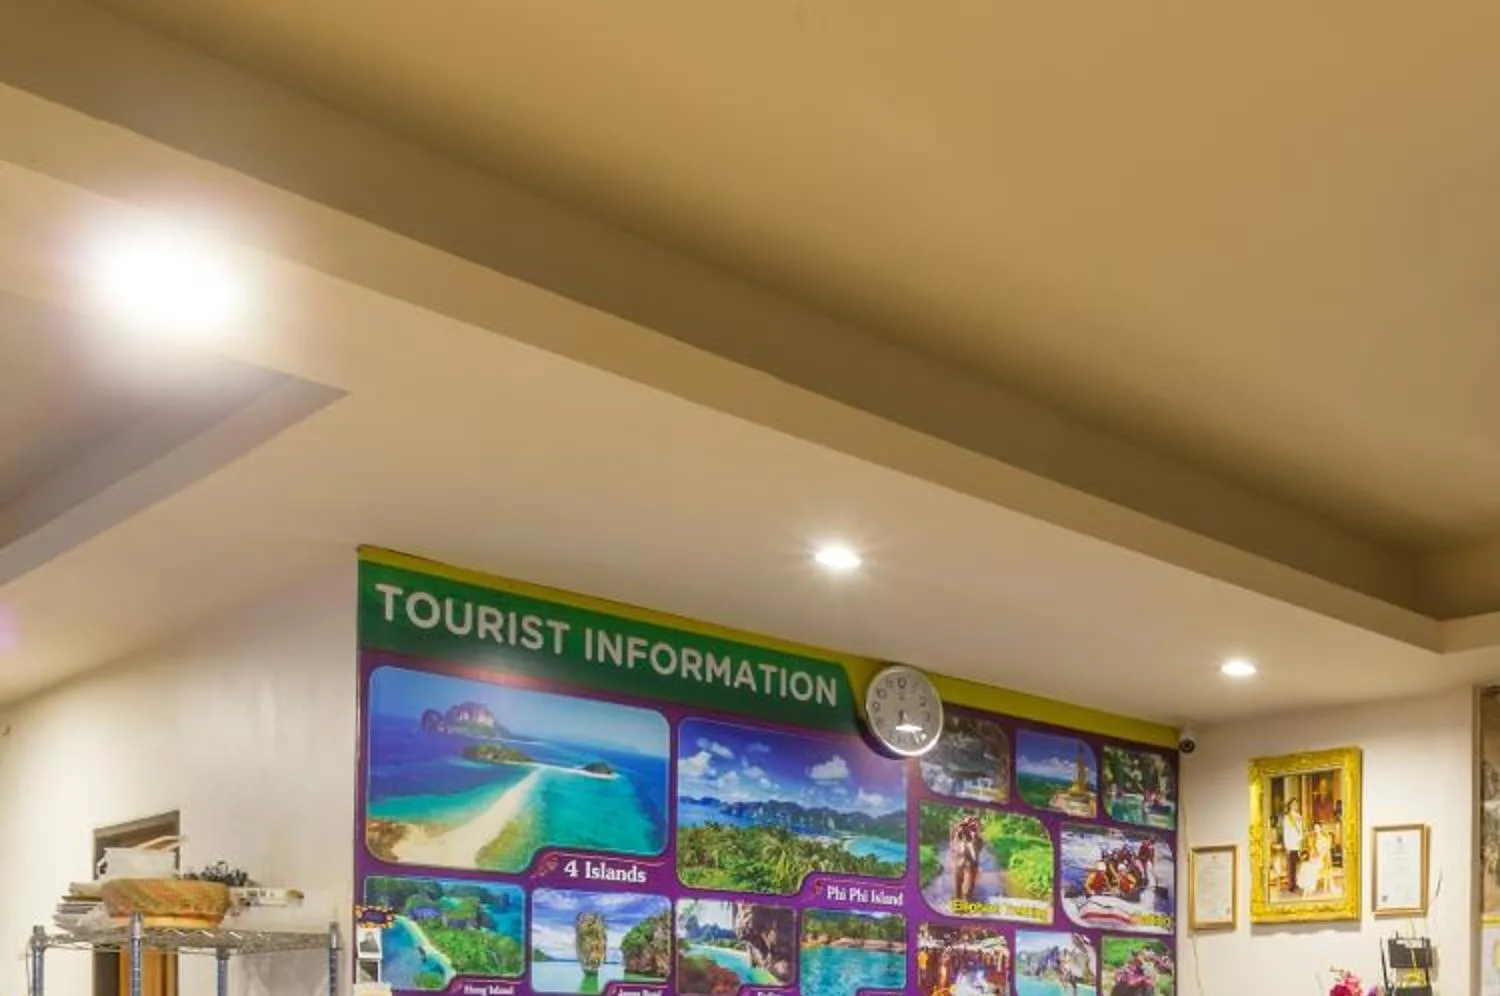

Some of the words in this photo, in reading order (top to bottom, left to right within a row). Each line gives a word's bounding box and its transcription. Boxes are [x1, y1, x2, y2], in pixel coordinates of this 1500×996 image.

[375, 584, 571, 655] TOURIST
[585, 627, 838, 706] INFORMATION
[563, 860, 579, 878] 4
[585, 861, 647, 883] Islands
[827, 885, 847, 900] Phi
[850, 888, 868, 903] Phi
[871, 889, 903, 906] Island
